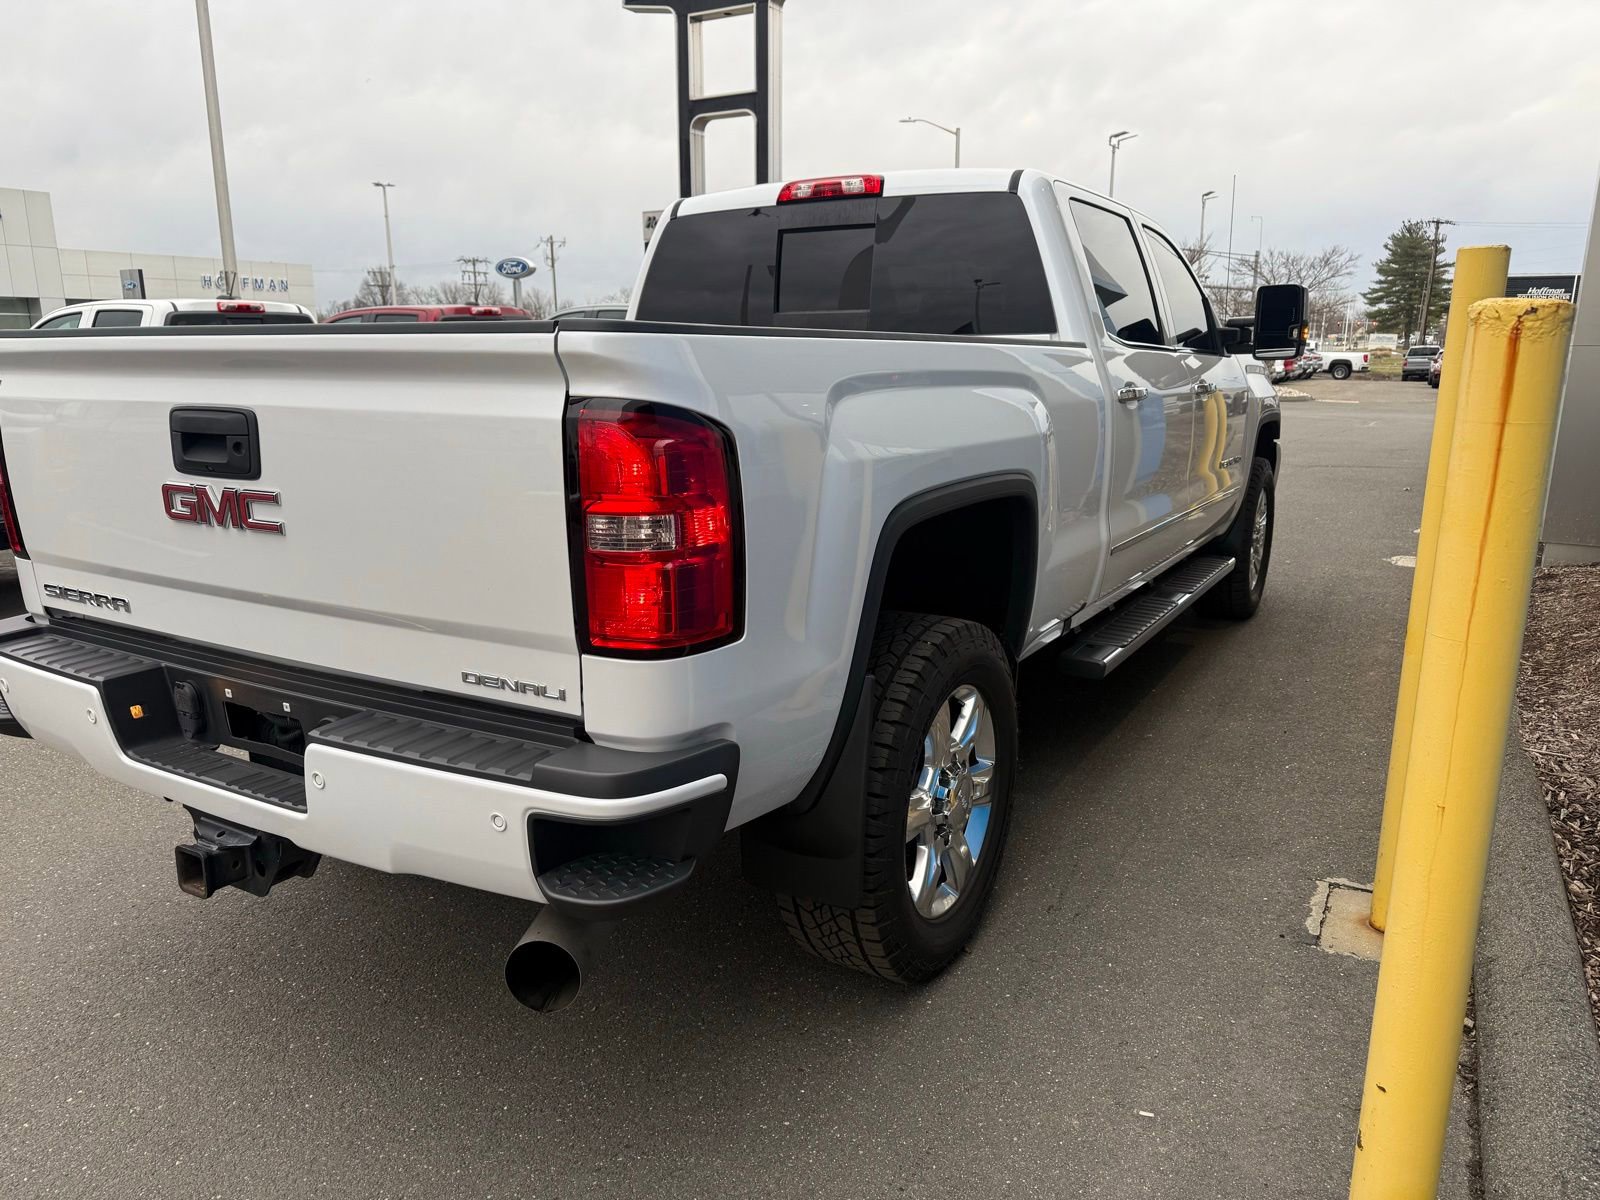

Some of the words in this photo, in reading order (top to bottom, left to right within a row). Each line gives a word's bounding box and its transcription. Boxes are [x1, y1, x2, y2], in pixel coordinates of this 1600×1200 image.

[201, 275, 289, 292] HOFMAN
[1527, 286, 1565, 295] Hoffman
[162, 481, 286, 536] GMC
[43, 583, 132, 614] SIERRA
[461, 670, 566, 701] DENALI
